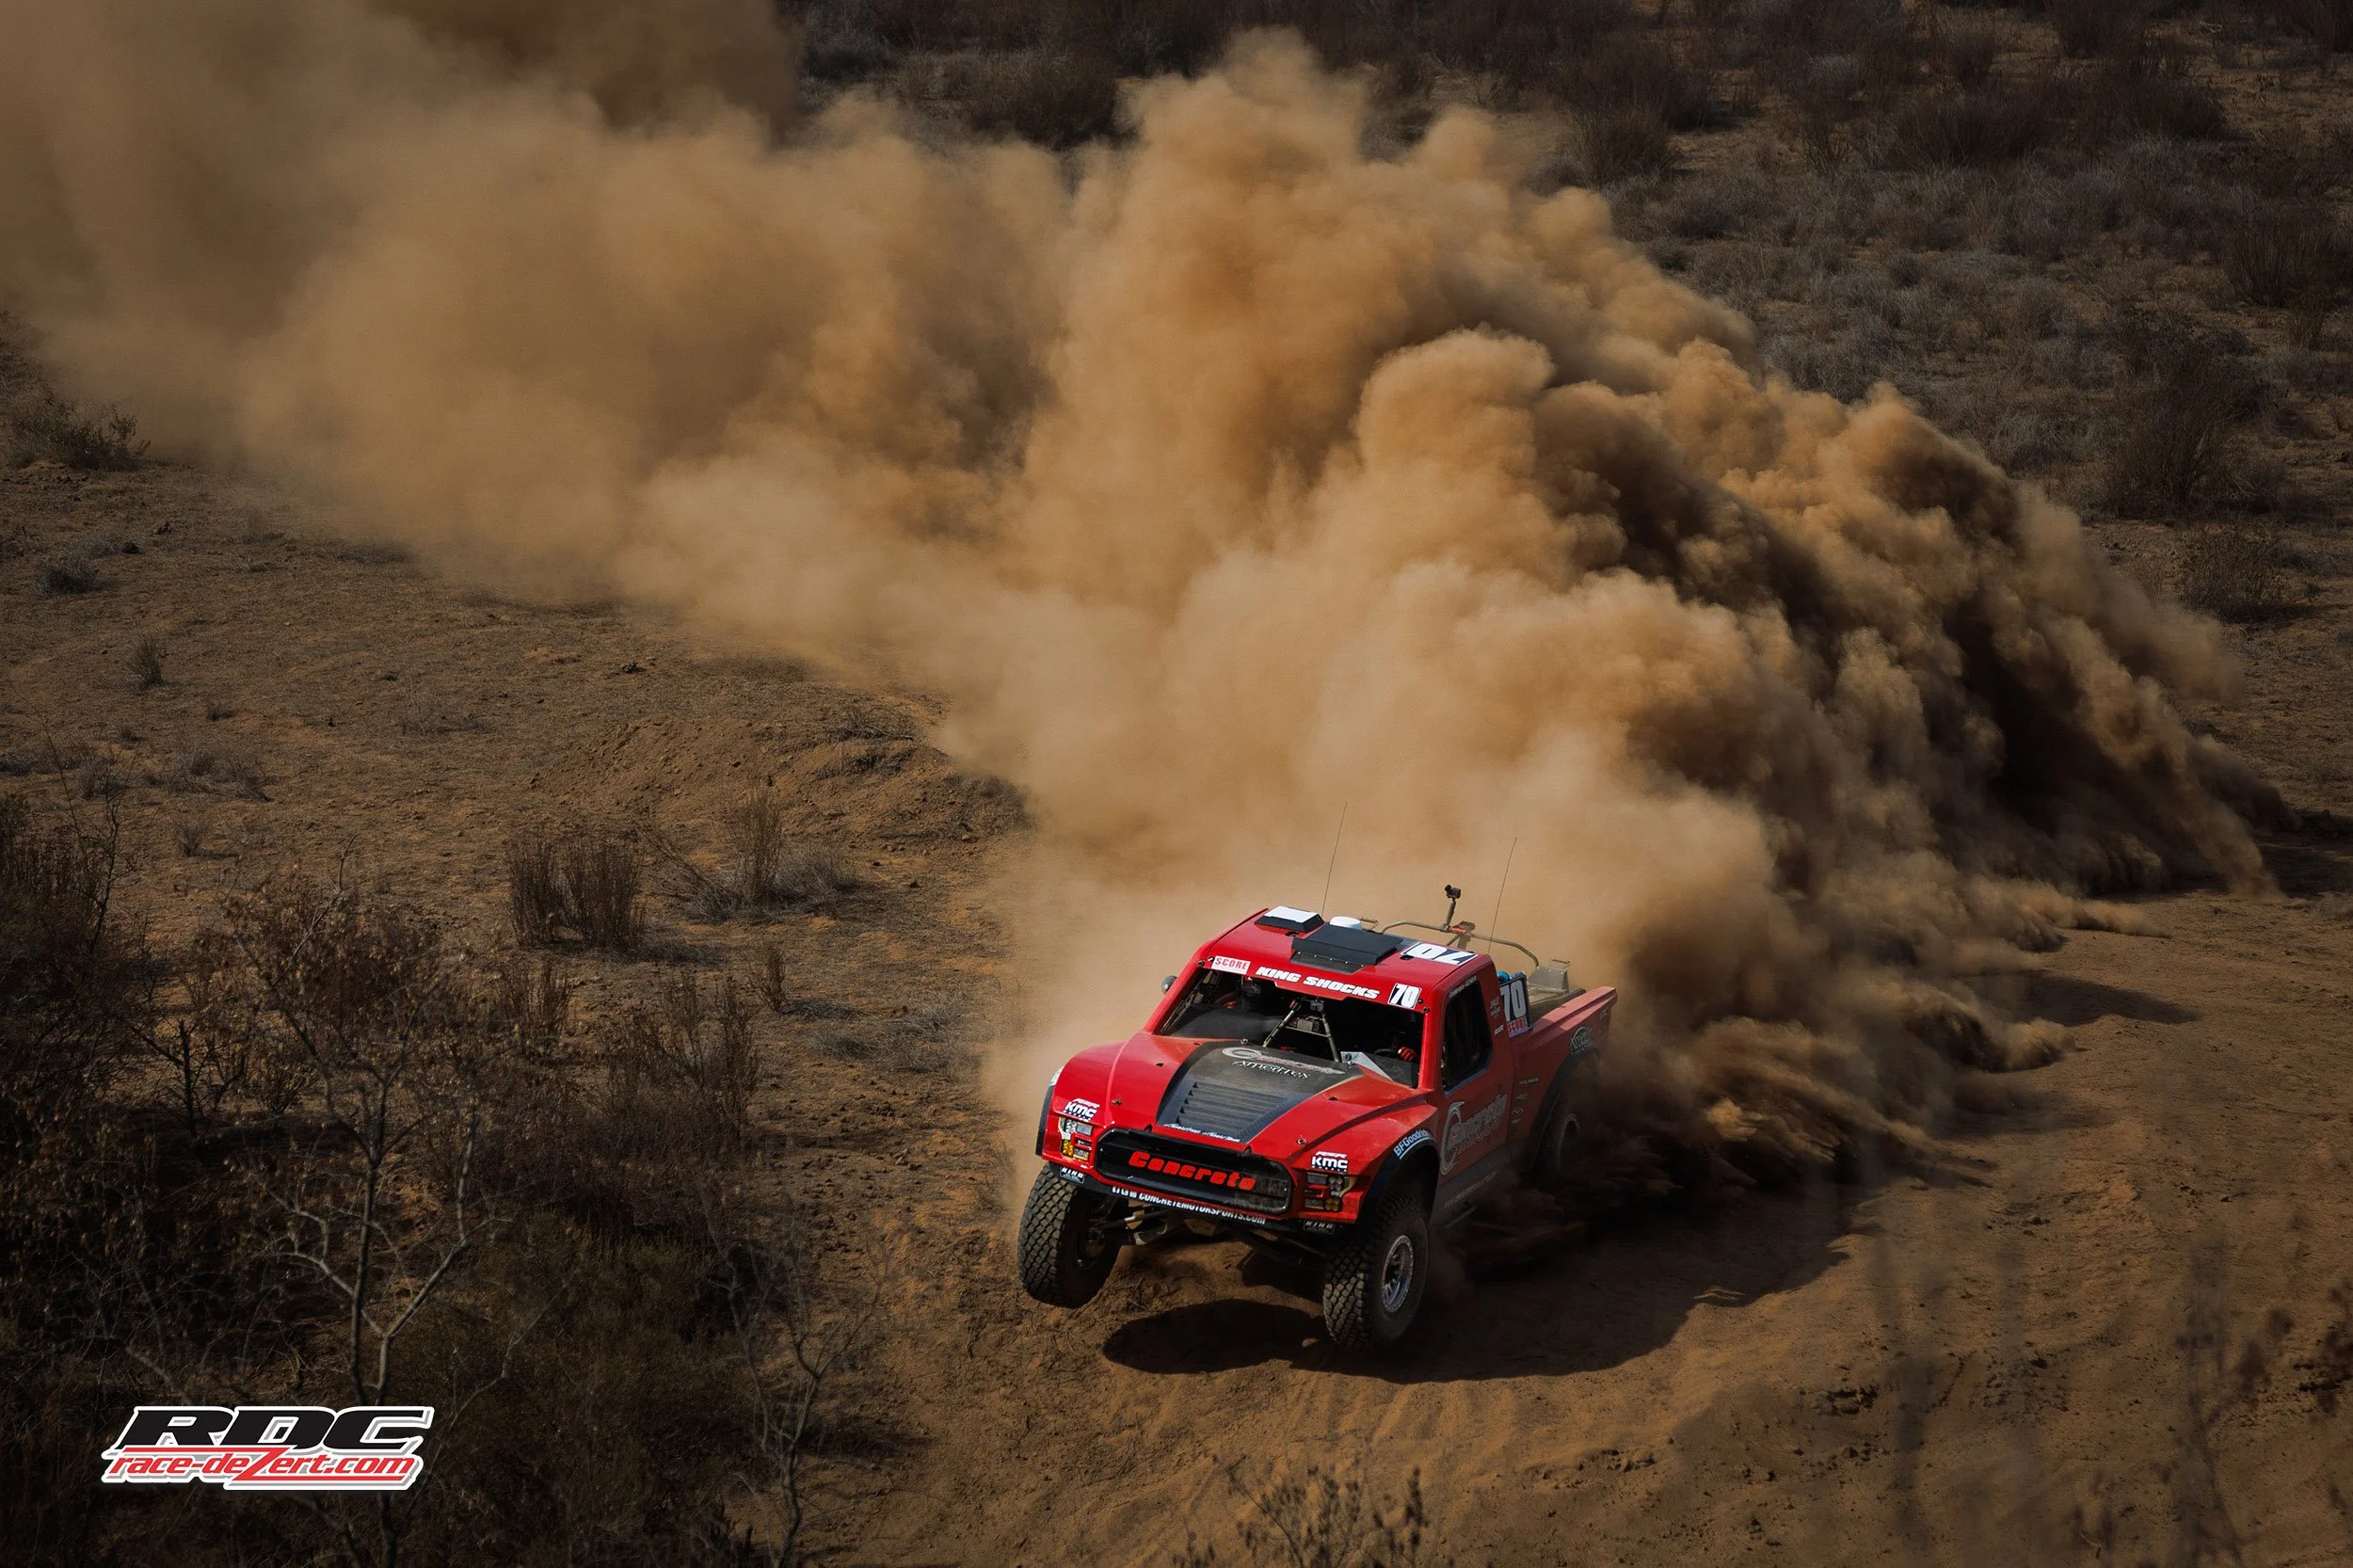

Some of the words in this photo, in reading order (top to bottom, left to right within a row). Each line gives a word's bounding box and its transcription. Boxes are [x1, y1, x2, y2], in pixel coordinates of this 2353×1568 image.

[1214, 957, 1249, 970] SCORE
[1256, 967, 1302, 983] KING
[1303, 976, 1380, 999] SHOCKS
[1392, 984, 1419, 1007] 70
[1500, 980, 1527, 1022] 70
[1064, 1101, 1097, 1118] KMC
[1128, 1151, 1257, 1191] Concrete
[1311, 1156, 1348, 1169] KMC
